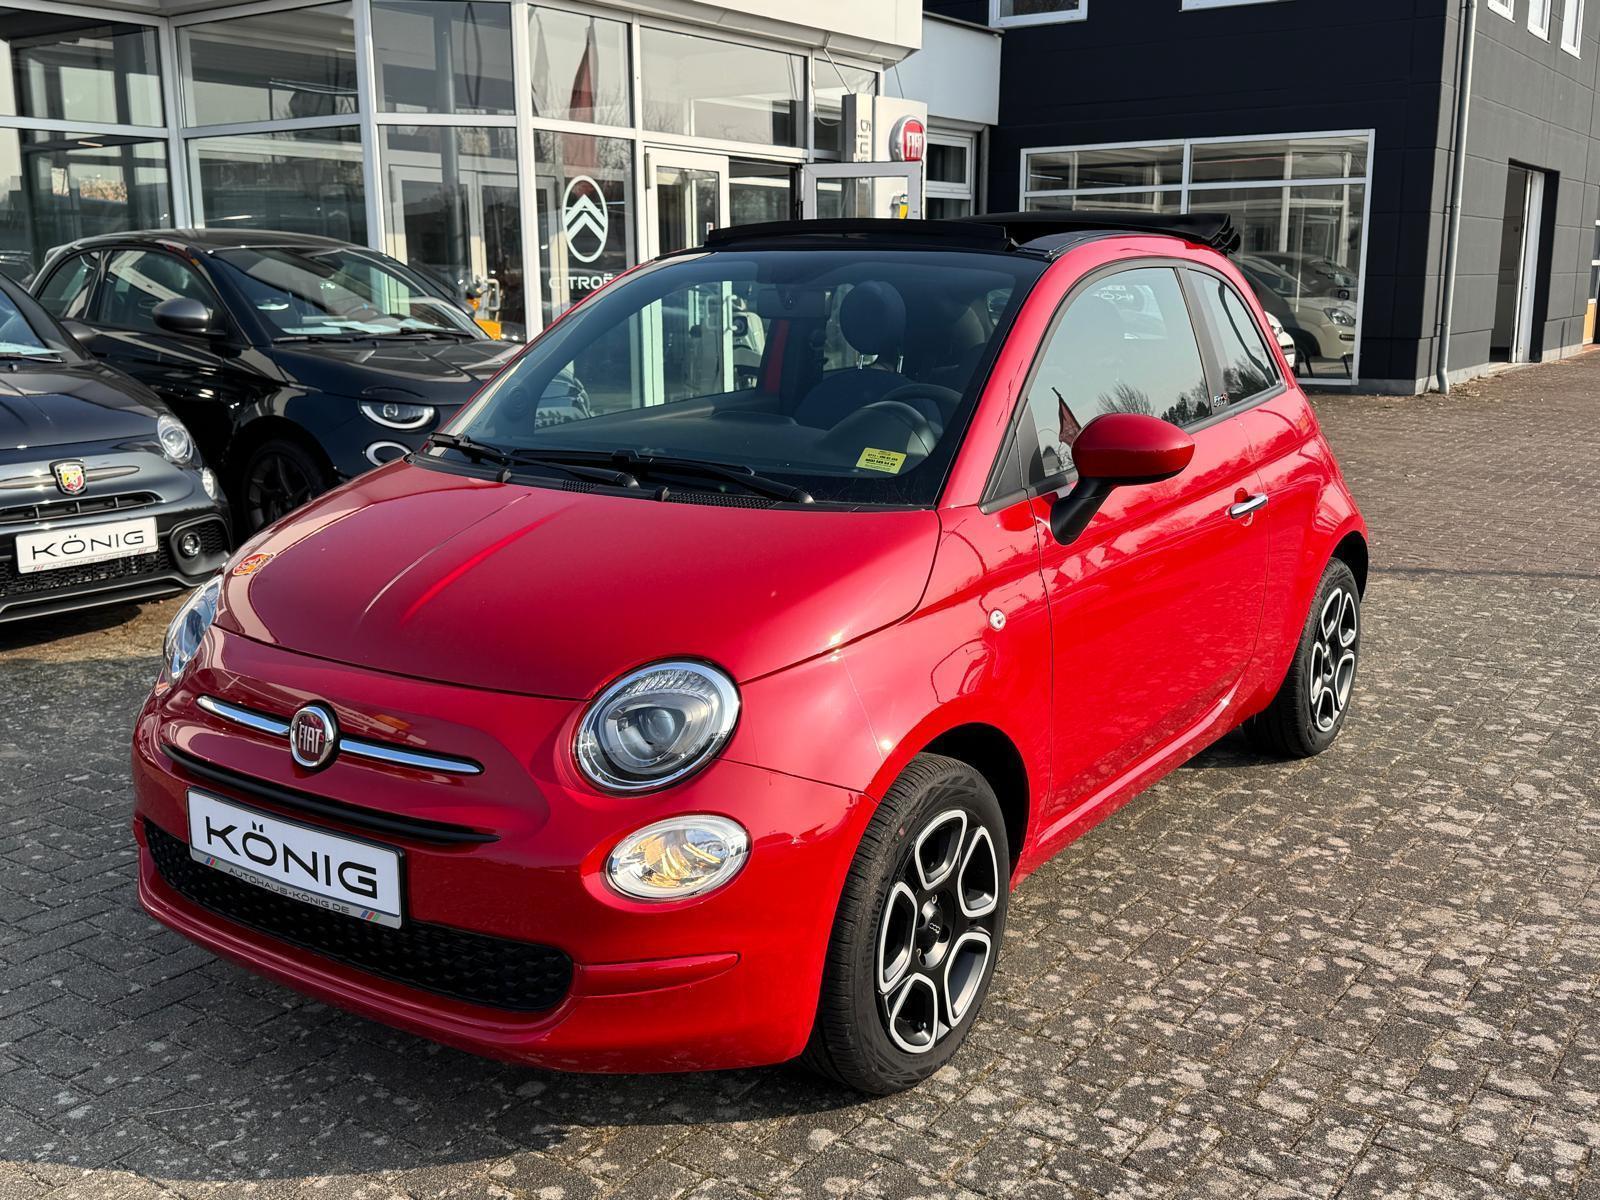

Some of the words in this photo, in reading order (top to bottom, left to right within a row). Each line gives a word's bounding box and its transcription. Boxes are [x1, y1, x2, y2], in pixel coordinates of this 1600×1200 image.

[857, 119, 871, 162] nig
[549, 273, 614, 290] CTROË
[32, 529, 145, 560] KÖNIG
[298, 724, 323, 754] FIAT
[205, 815, 378, 900] KÖNIG
